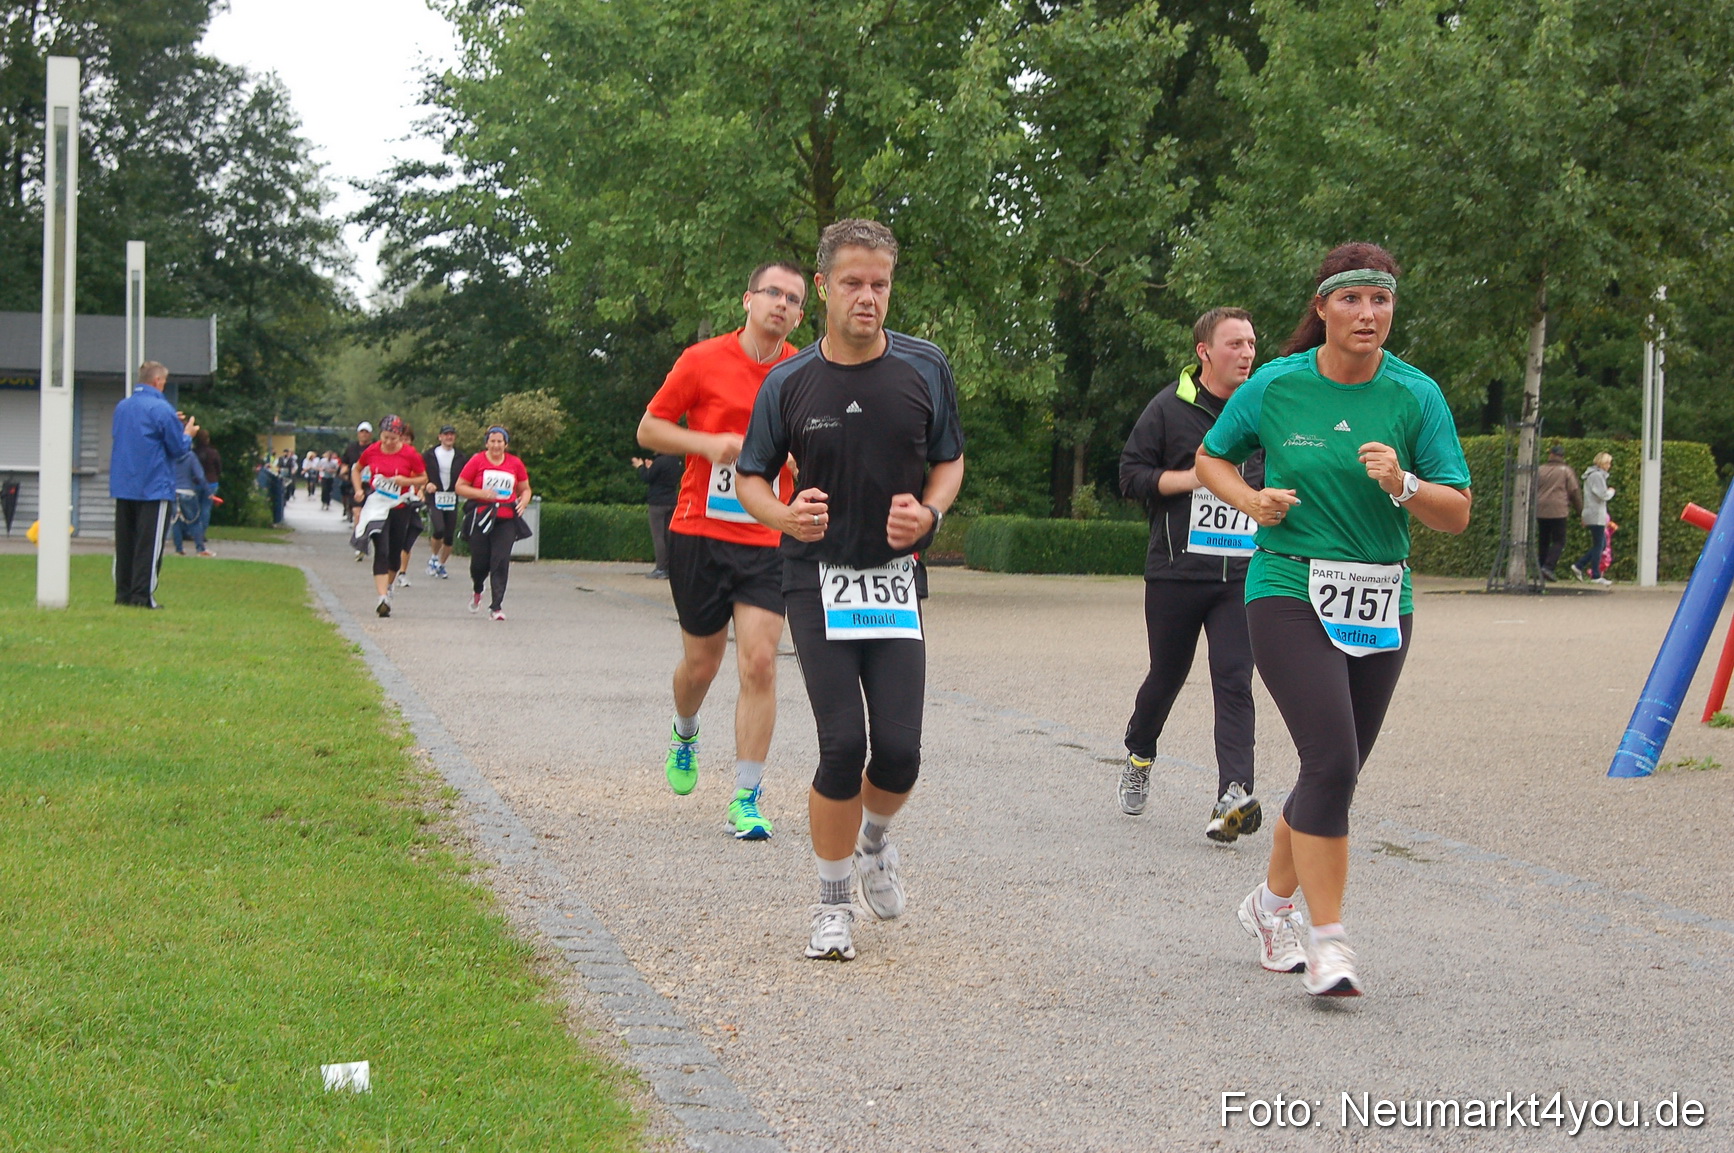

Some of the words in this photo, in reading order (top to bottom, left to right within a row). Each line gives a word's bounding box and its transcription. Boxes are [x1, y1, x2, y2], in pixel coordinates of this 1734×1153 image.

[1206, 536, 1242, 547] andreas
[1312, 569, 1346, 580] PARTL
[1348, 573, 1390, 584] Neumarkt
[832, 574, 909, 604] 2156
[1319, 584, 1393, 622] 2157
[852, 613, 896, 626] Ronald
